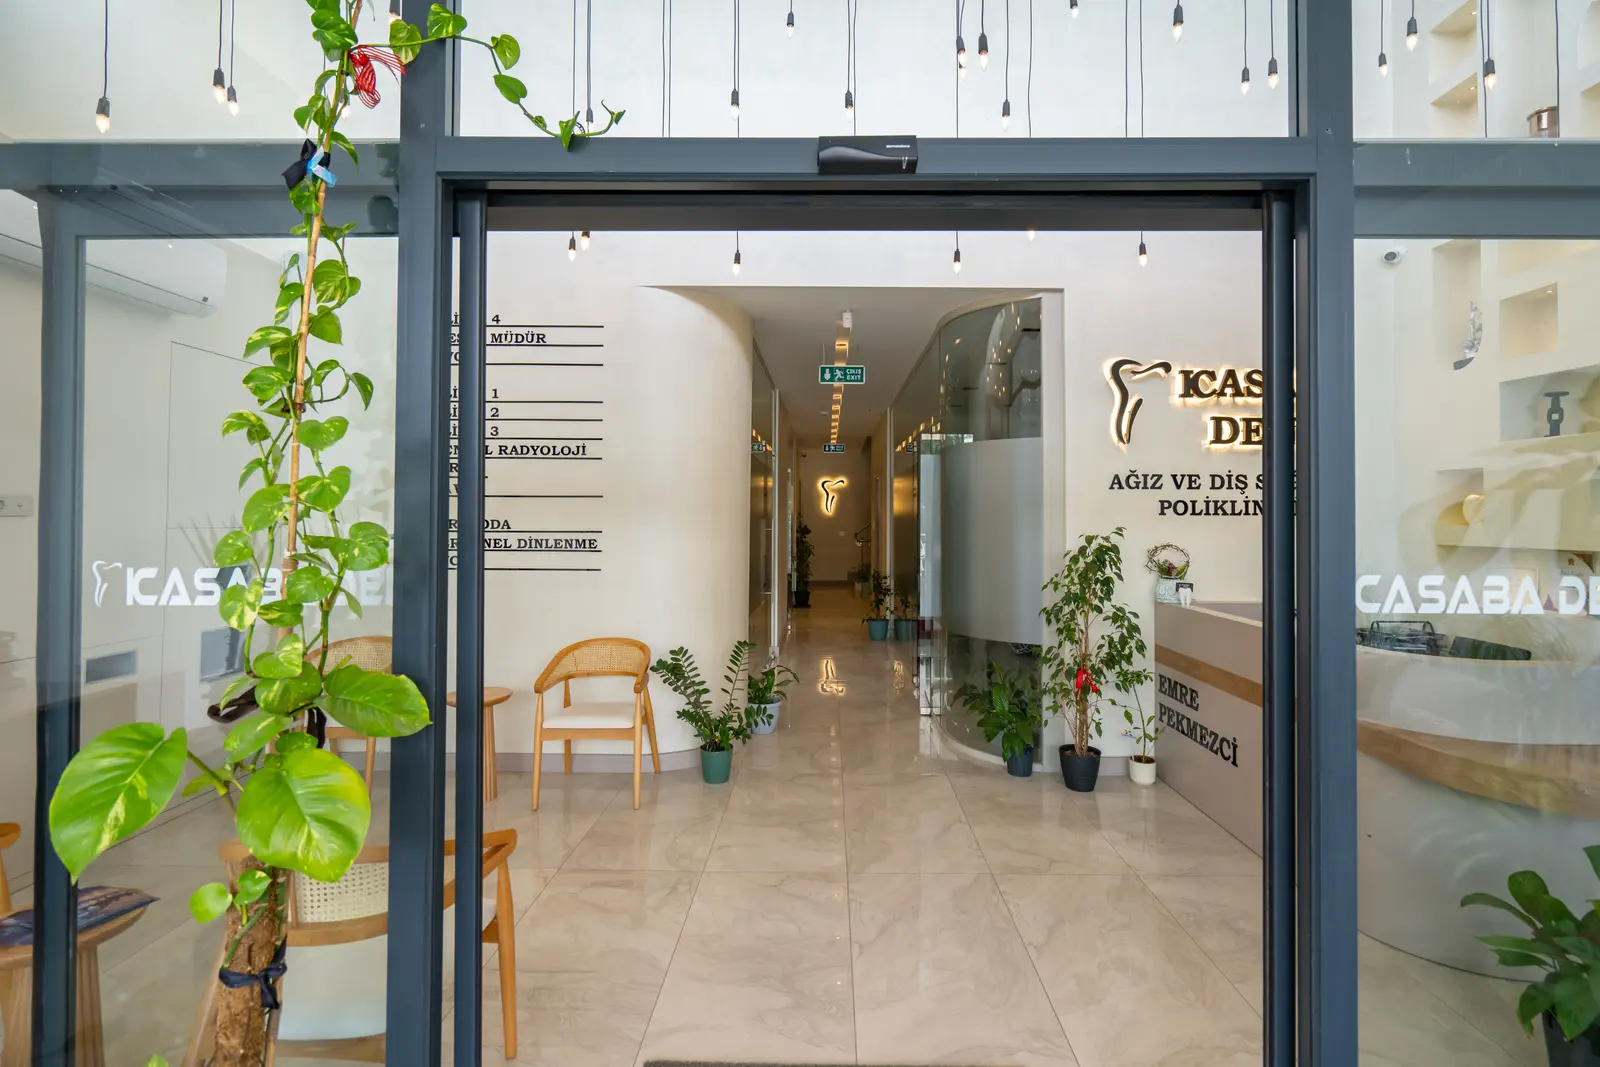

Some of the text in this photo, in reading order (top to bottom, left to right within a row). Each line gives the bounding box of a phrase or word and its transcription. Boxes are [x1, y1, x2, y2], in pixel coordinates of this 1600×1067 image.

[491, 314, 501, 325] 4
[490, 331, 547, 344] MÜDÜR
[491, 388, 499, 399] 1
[490, 407, 500, 418] 2
[490, 426, 499, 437] 3
[1209, 416, 1263, 445] DE
[497, 443, 587, 456] RADYOLOJİ
[1109, 469, 1164, 490] AĞIZ
[1170, 474, 1202, 490] VE
[1209, 470, 1249, 495] DİŞ
[517, 536, 598, 549] DİNLENME
[1158, 673, 1200, 712] EMRE
[1158, 702, 1239, 768] PEKMEZCİ
